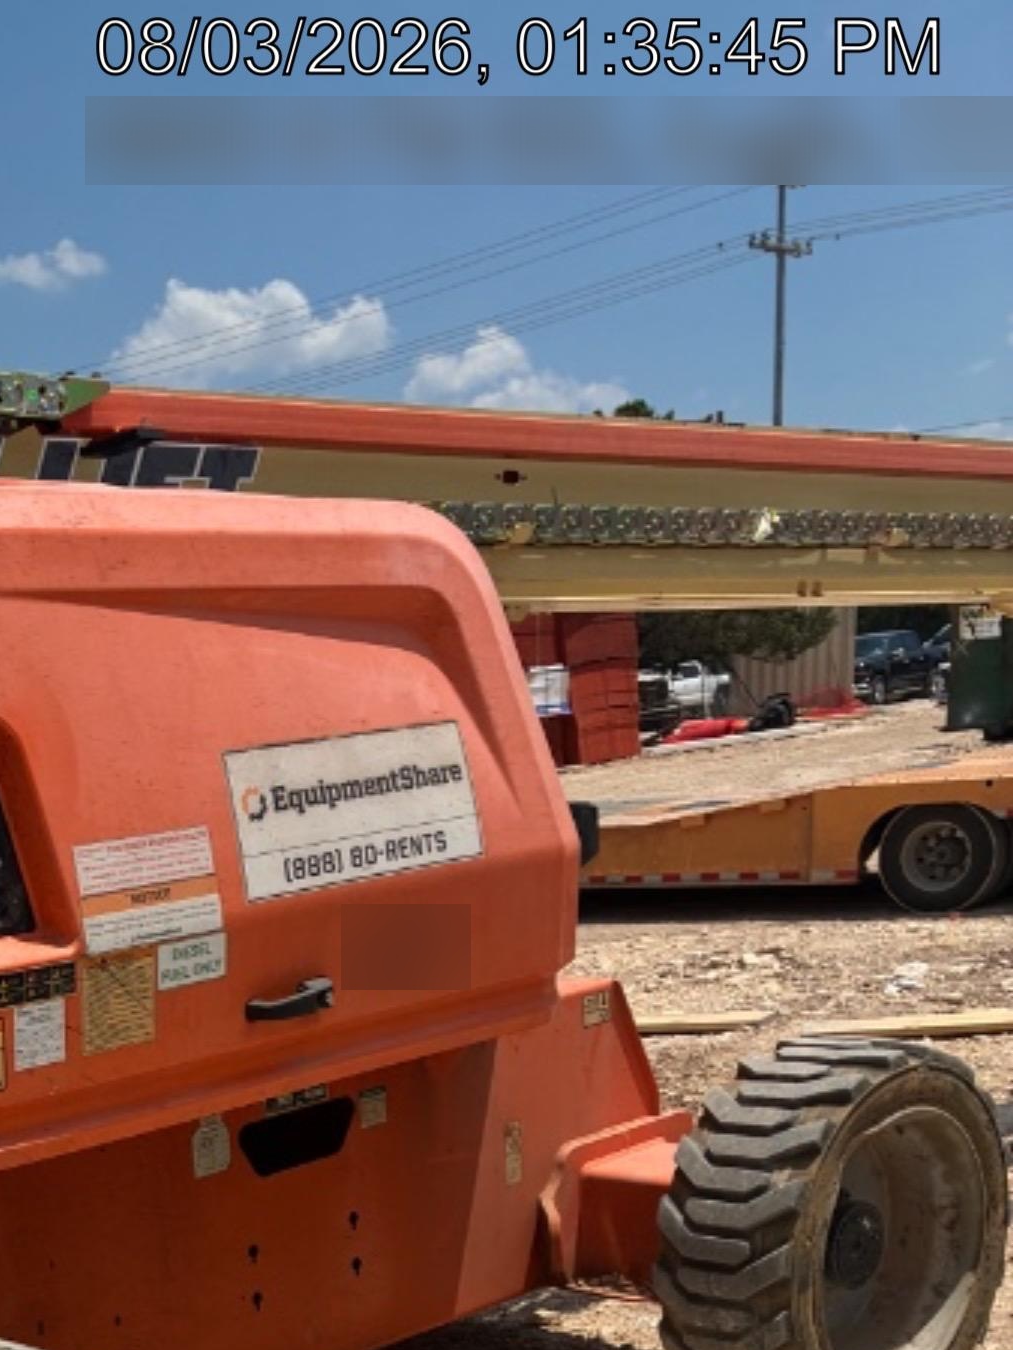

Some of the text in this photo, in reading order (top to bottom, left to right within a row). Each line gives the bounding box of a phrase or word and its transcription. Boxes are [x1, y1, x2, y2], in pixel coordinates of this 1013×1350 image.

[269, 764, 463, 815] EquipmentShare
[284, 830, 448, 882] (888) 80-RENTS
